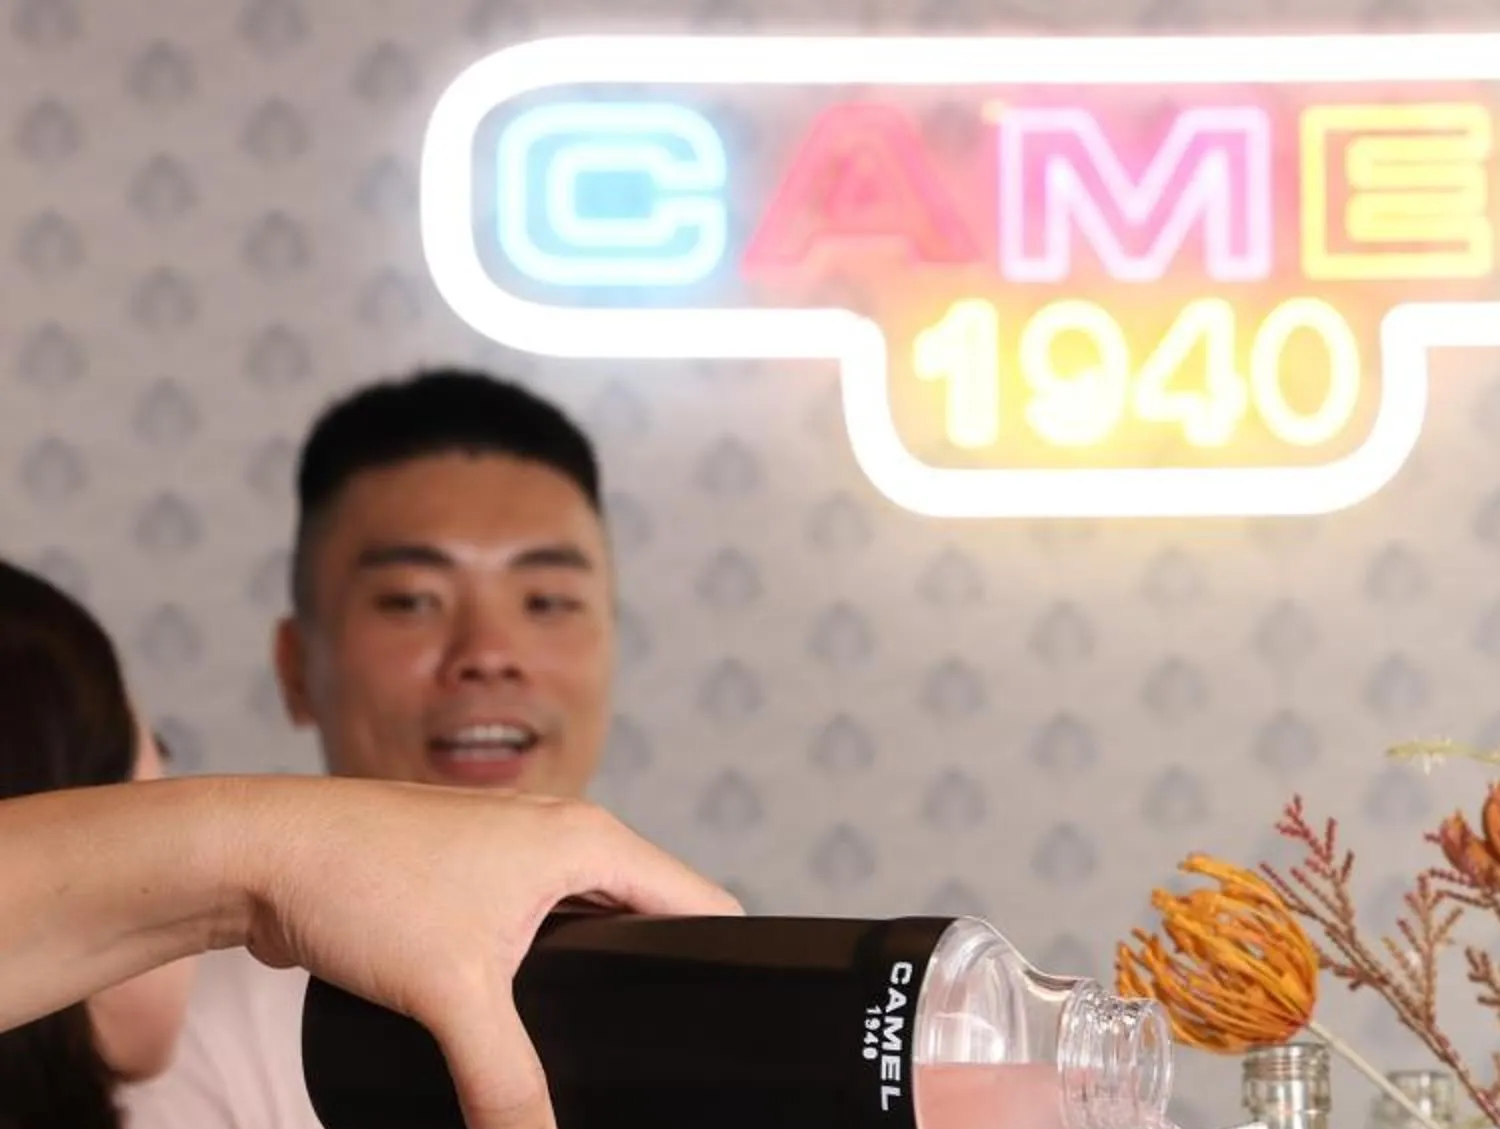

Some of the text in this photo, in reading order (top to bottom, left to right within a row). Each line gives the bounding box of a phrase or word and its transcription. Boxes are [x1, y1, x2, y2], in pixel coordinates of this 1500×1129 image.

[911, 296, 1361, 450] 1940
[862, 1005, 881, 1060] 1940
[880, 961, 913, 1111] CAMEL
